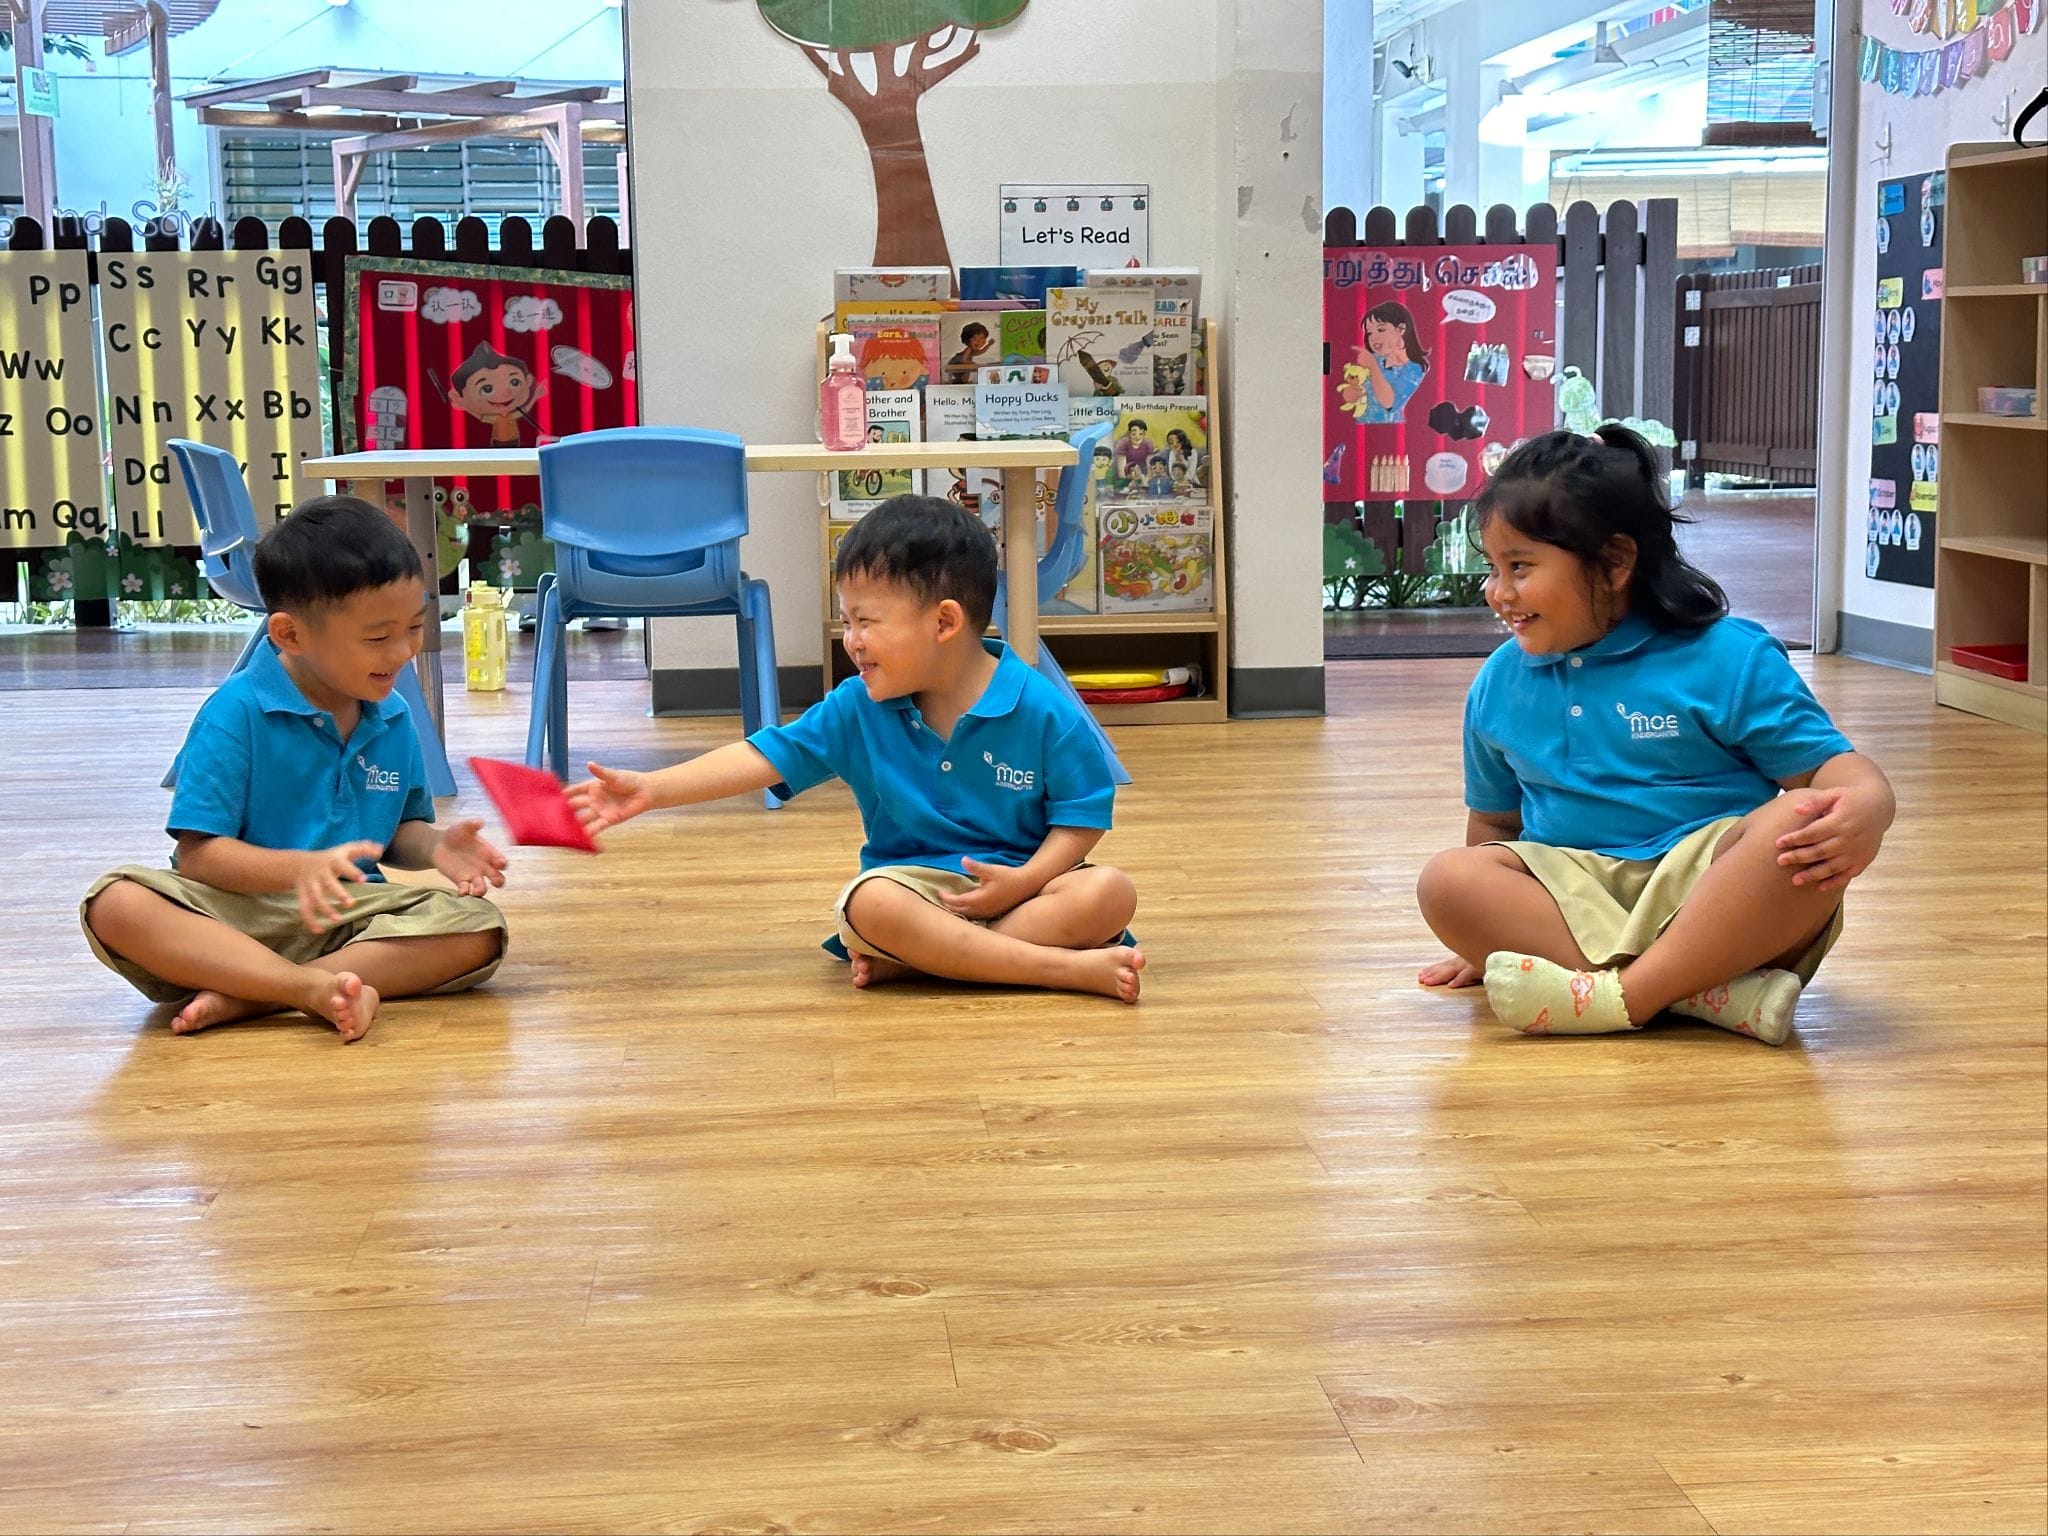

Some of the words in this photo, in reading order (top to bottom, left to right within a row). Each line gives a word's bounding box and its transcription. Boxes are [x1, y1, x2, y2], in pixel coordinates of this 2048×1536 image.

[57, 201, 108, 238] nd
[132, 200, 218, 247] Say!
[1022, 226, 1074, 244] Let's
[1081, 226, 1130, 244] Read
[1074, 297, 1100, 314] My
[1154, 300, 1176, 312] EAD
[1051, 311, 1112, 329] Crayons
[1115, 310, 1148, 327] Talk
[866, 394, 890, 404] other
[894, 393, 913, 403] and
[985, 393, 1022, 407] Happy
[1025, 392, 1059, 403] Ducks
[1120, 403, 1133, 412] My
[1135, 402, 1168, 413] Birthday
[1169, 402, 1198, 411] Present
[868, 408, 907, 418] Brother
[125, 455, 170, 485] Dd
[0, 507, 36, 530] m
[1631, 714, 1678, 732] MOE
[996, 766, 1035, 785] MOE
